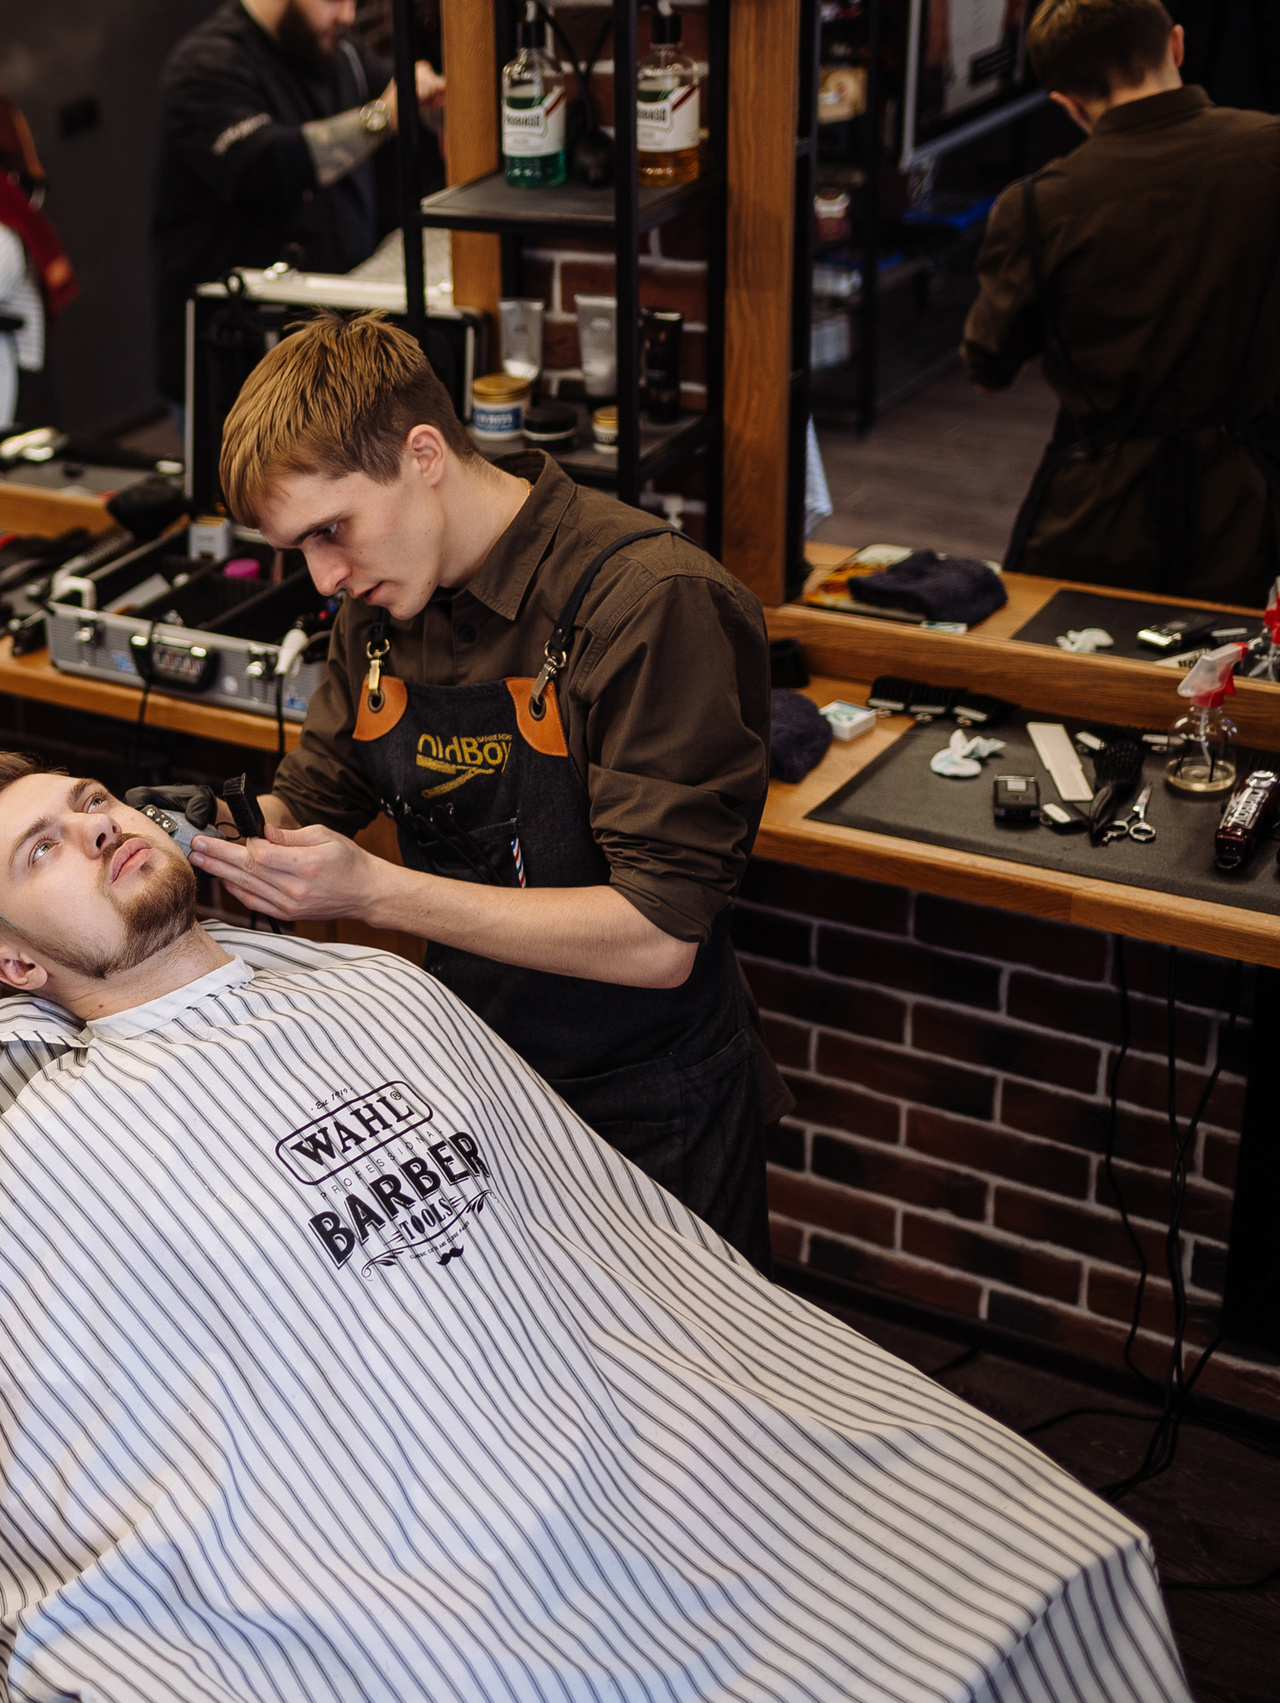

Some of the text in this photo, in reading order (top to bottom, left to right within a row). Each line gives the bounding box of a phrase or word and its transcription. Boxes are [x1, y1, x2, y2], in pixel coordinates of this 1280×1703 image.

[290, 1096, 415, 1166] WAHL
[308, 1131, 491, 1270] BARBER
[399, 1196, 455, 1241] TOOLS
